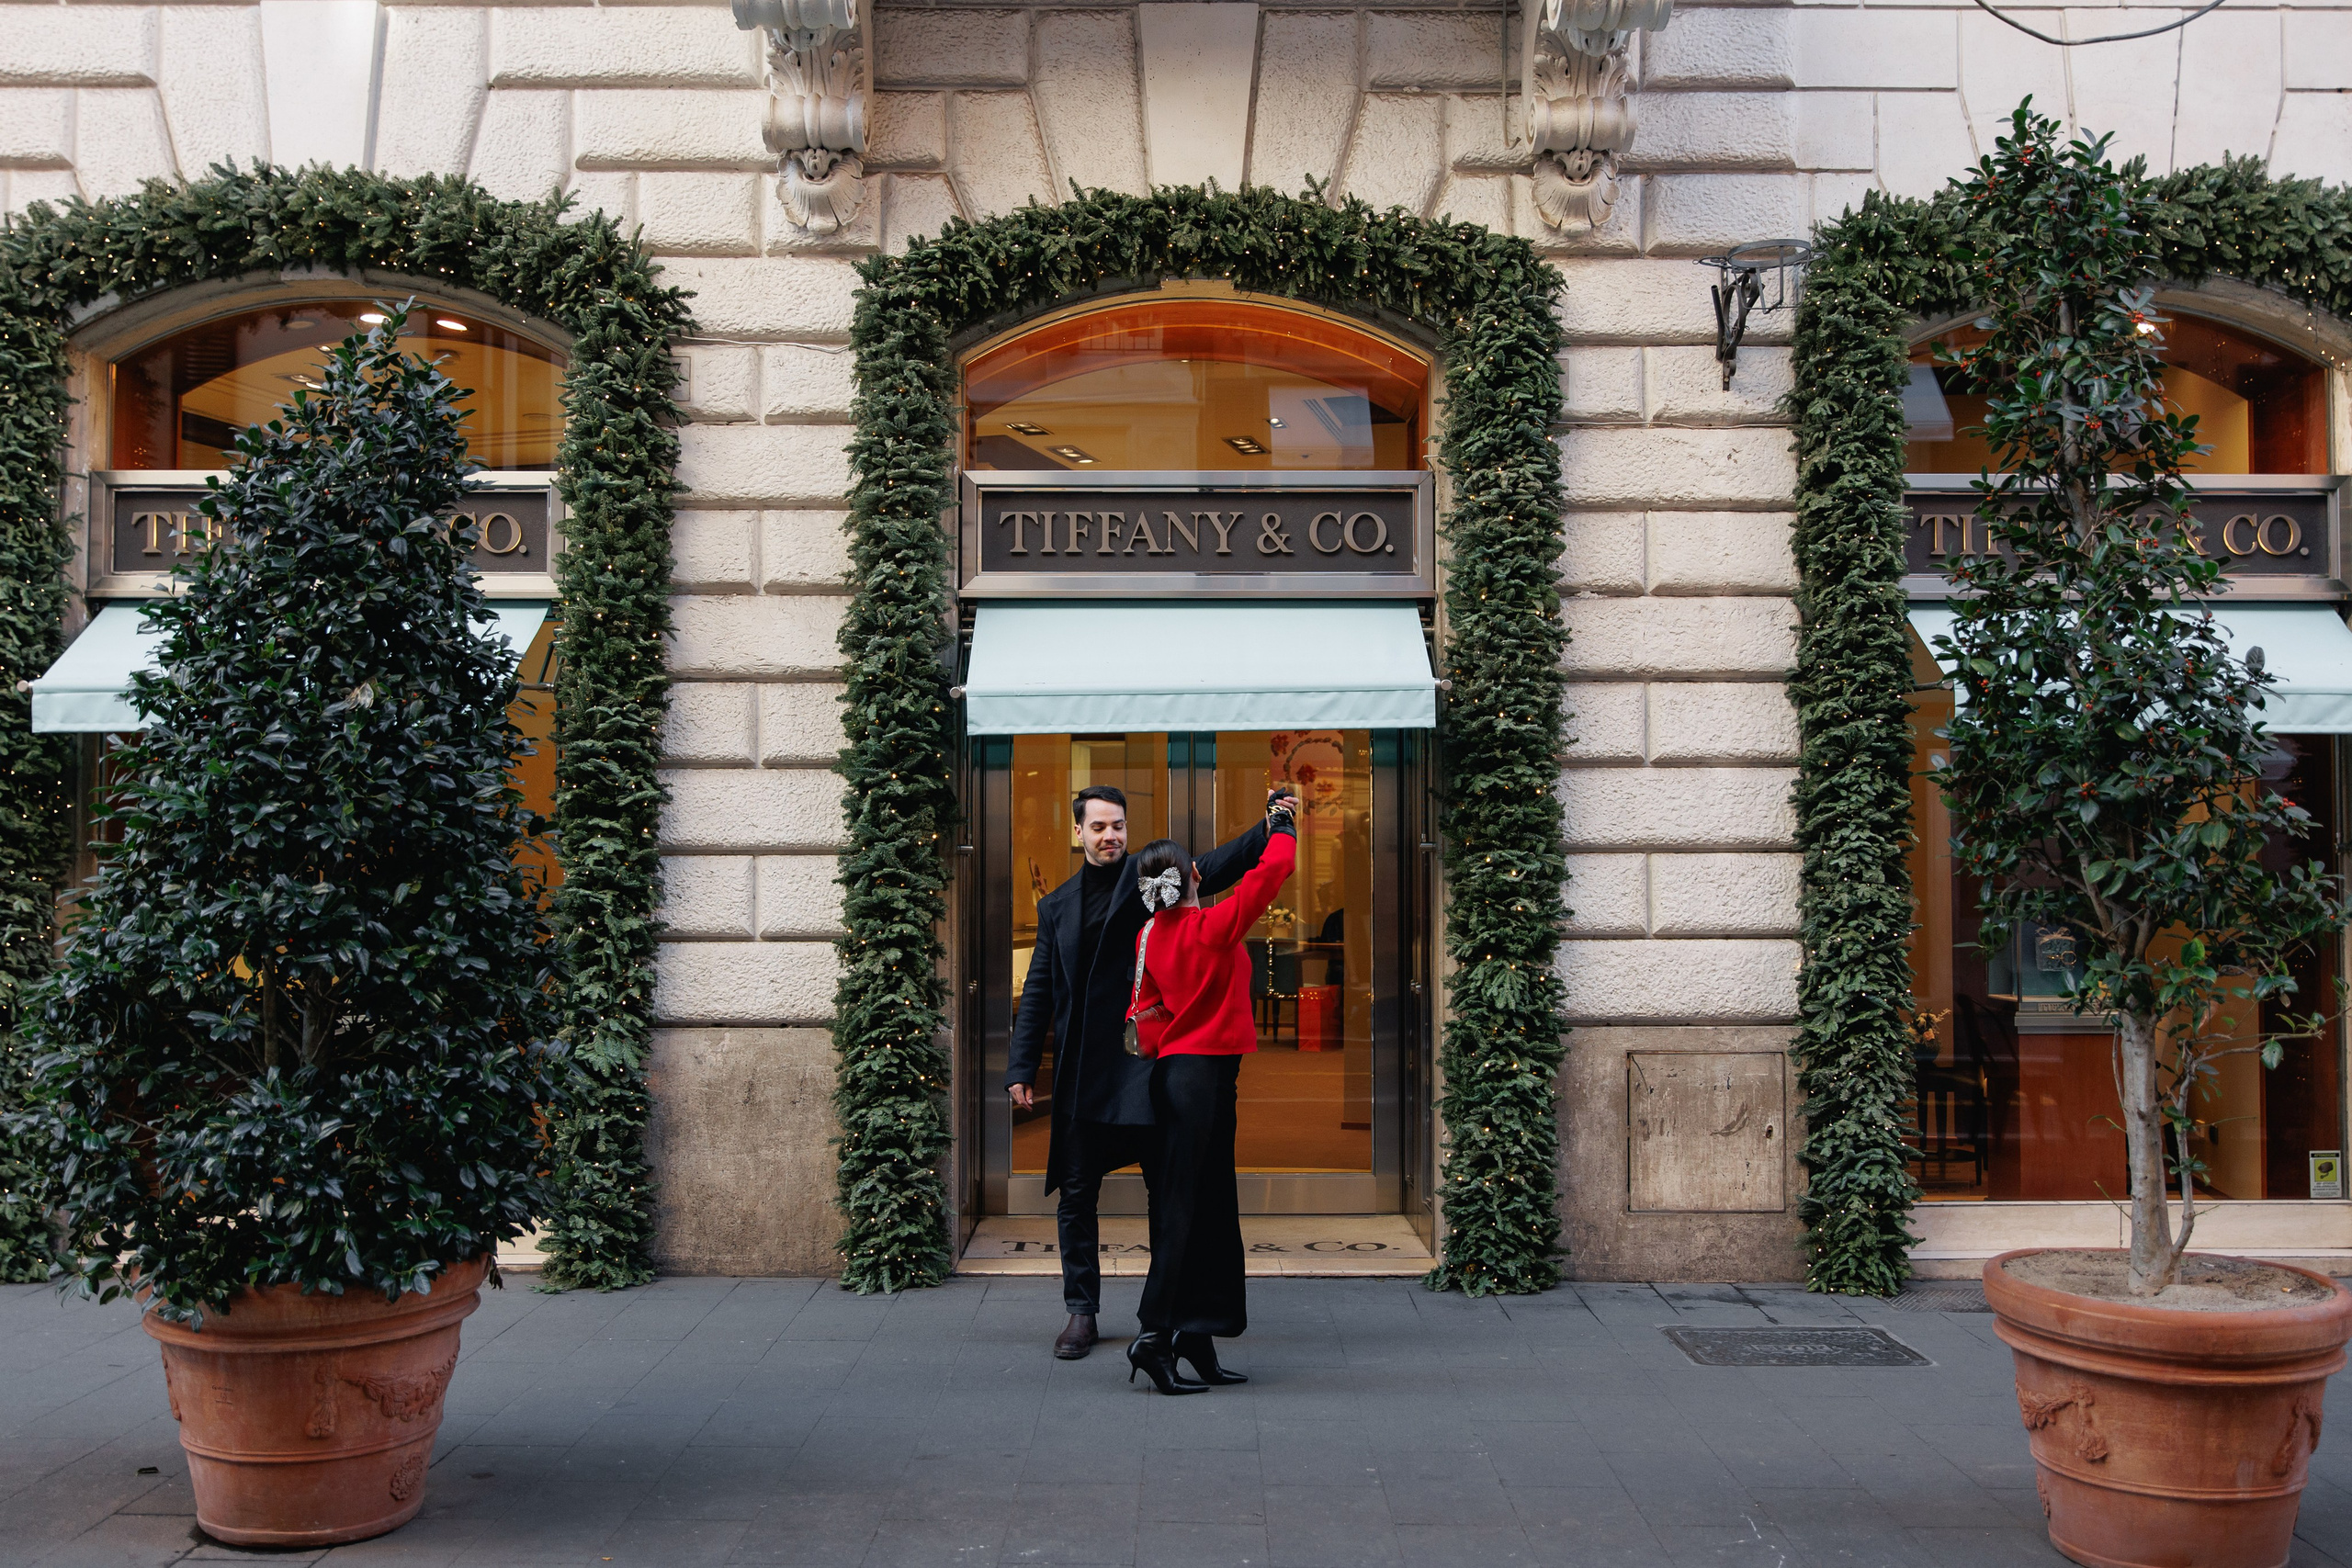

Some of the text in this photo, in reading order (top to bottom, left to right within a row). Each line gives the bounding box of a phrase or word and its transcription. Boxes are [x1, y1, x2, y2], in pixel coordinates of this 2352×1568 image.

[999, 511, 1395, 555] TIFFANY & CO.
[2222, 513, 2310, 557] CO.
[1001, 1240, 1151, 1253] TIFA
[1249, 1242, 1291, 1253] &
